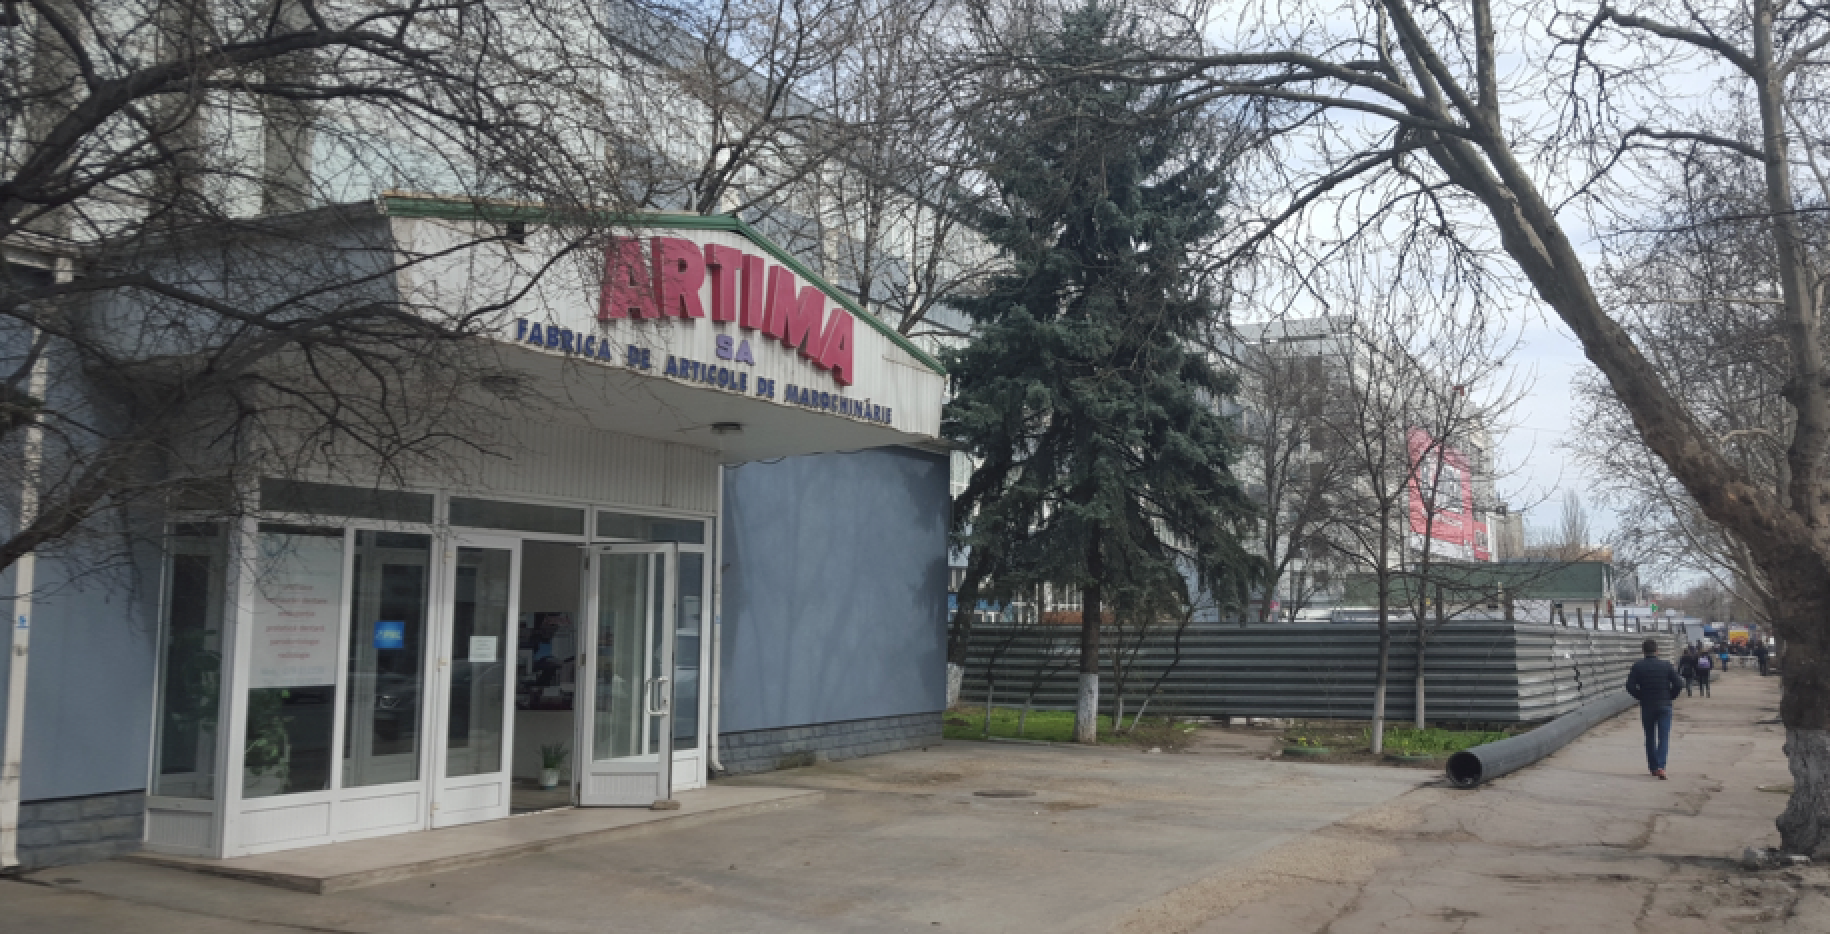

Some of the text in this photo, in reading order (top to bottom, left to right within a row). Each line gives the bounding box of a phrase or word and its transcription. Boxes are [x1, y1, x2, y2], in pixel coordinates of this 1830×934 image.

[600, 235, 853, 386] ARTIMA
[716, 334, 754, 366] SA
[516, 318, 612, 361] FABRICA
[626, 344, 651, 370] DE
[664, 355, 748, 393] ARTICOLE
[757, 376, 775, 398] DE
